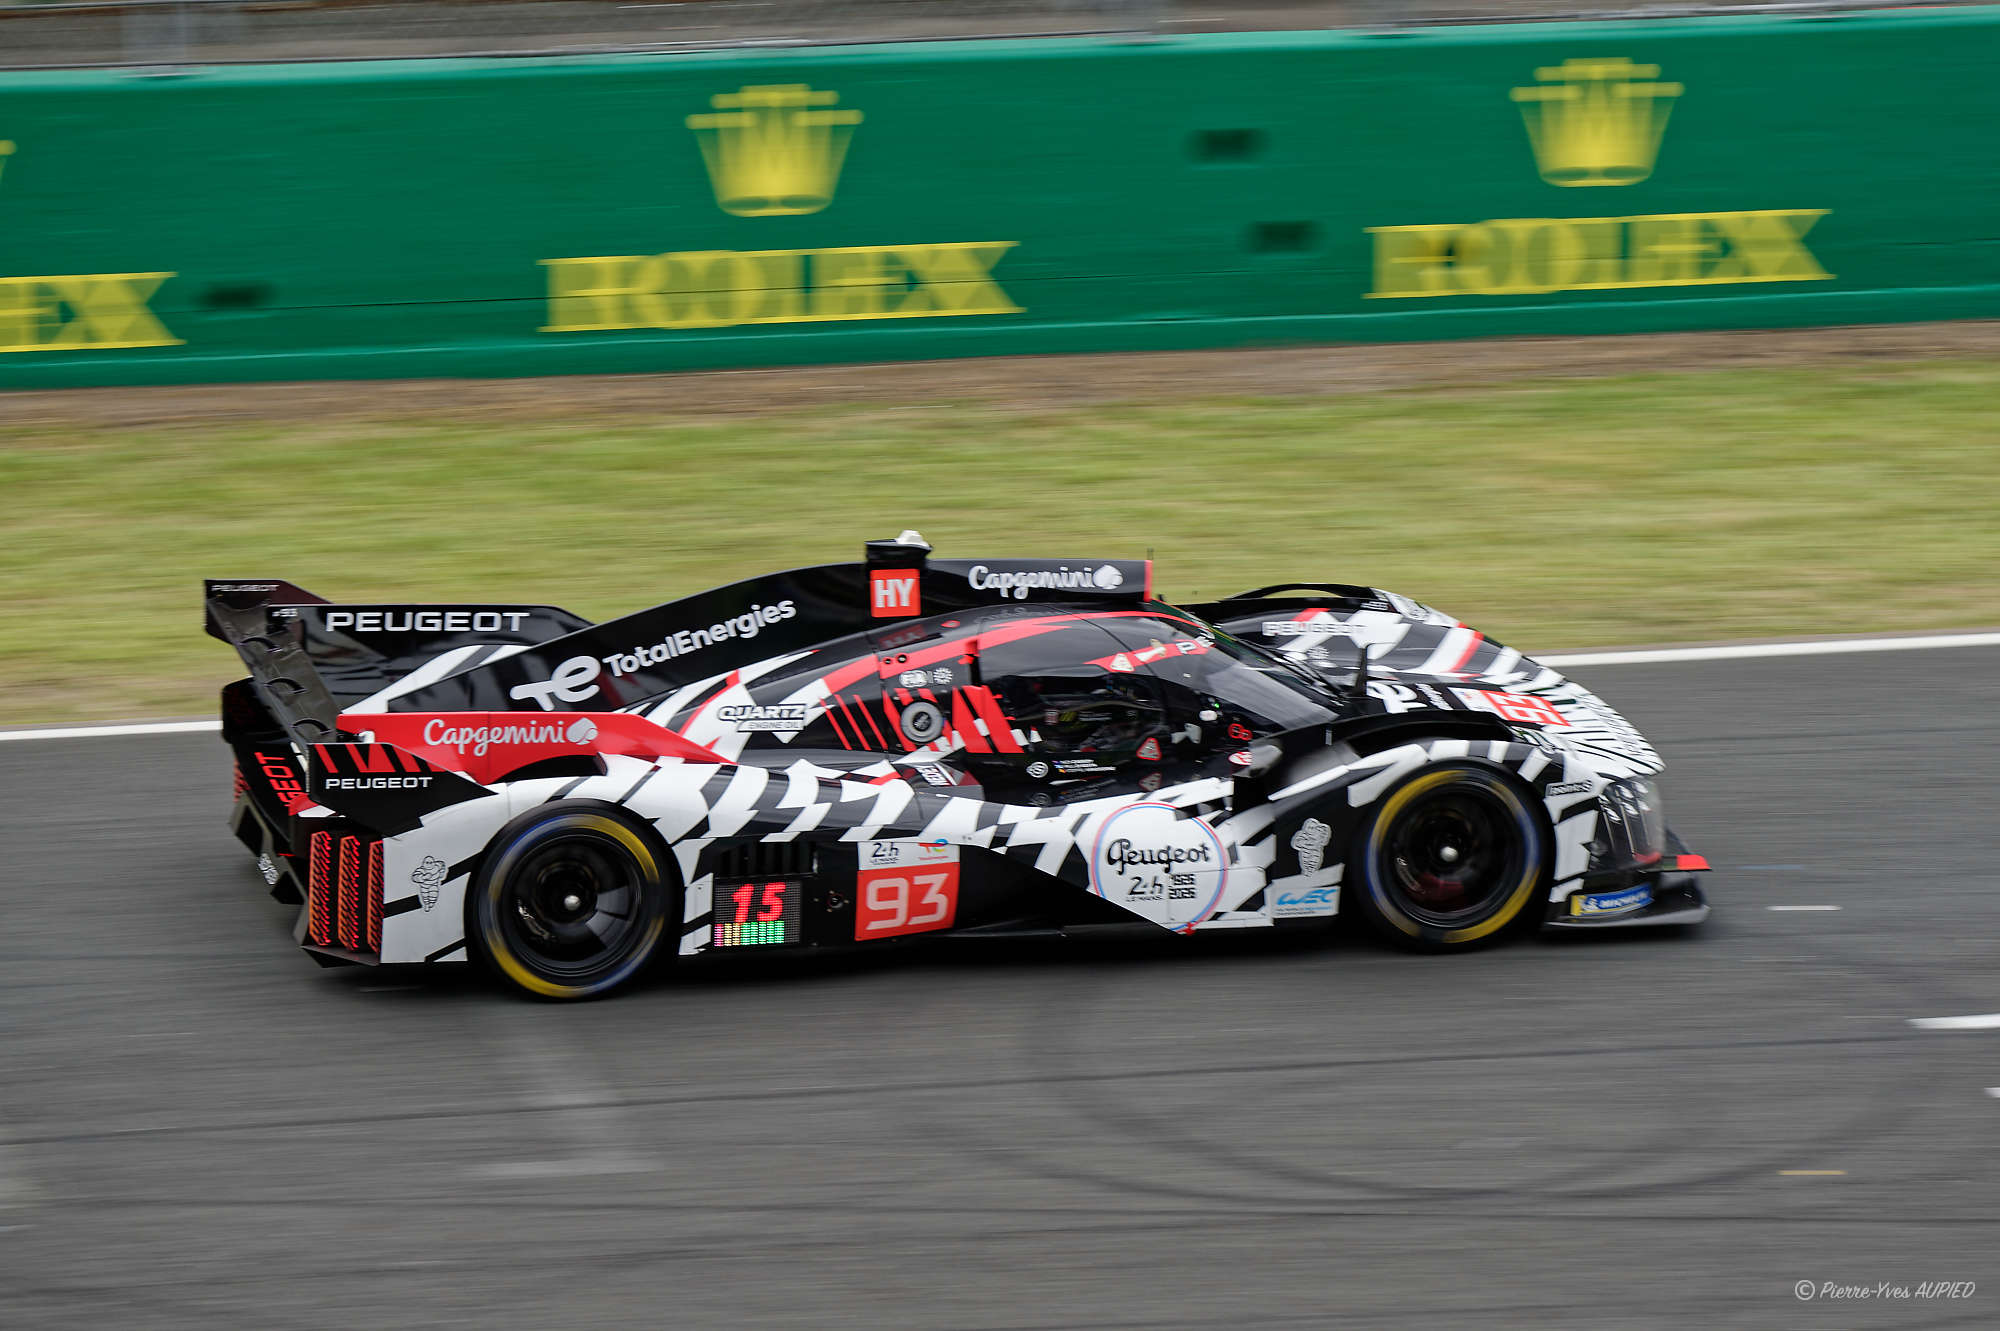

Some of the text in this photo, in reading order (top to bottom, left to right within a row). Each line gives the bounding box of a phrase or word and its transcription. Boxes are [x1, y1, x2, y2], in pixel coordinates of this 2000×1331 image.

[1365, 208, 1837, 299] ROLEX
[537, 240, 1027, 333] ROLEX
[875, 578, 914, 608] HY
[969, 565, 1093, 600] Capgemini
[325, 611, 530, 632] PEUGEOT
[602, 600, 797, 677] TotalEnergies
[718, 704, 807, 722] QUARTZ
[424, 718, 564, 757] Capgemini
[325, 776, 433, 790] PEUGEOT
[1107, 838, 1210, 875] Peugeot
[730, 881, 787, 926] 15
[866, 872, 949, 931] 93
